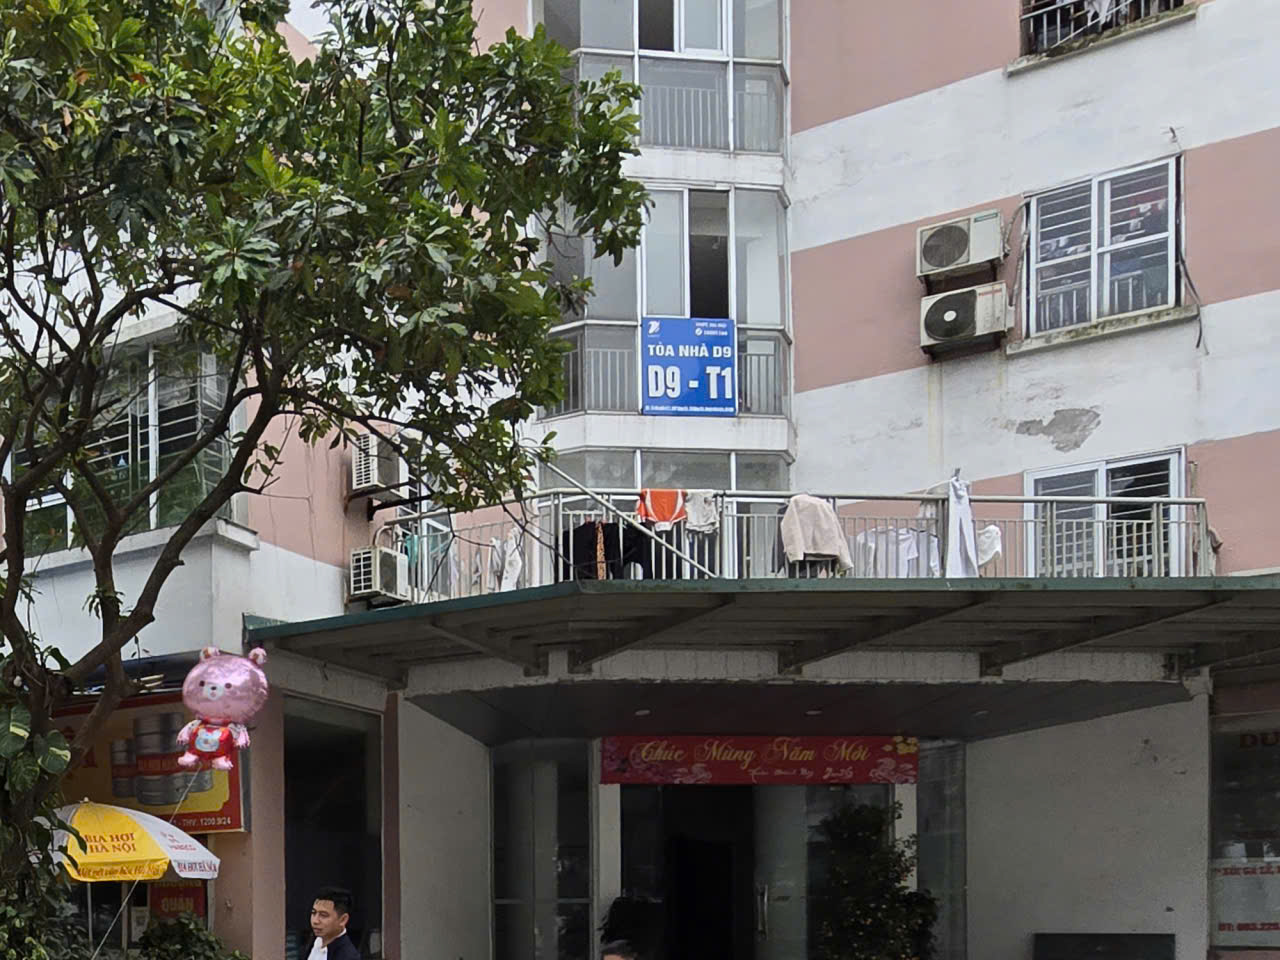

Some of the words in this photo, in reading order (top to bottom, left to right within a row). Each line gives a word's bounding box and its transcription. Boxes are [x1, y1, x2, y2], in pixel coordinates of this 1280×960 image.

[648, 341, 675, 356] TÒA
[679, 343, 709, 357] NHÀ
[713, 346, 732, 358] D9
[648, 365, 680, 398] D9
[706, 366, 733, 399] T1
[635, 740, 686, 761] Chúc
[770, 738, 816, 761] Năm
[84, 833, 107, 843] BIA
[109, 832, 134, 842] HƠI
[89, 842, 109, 853] HÀ
[112, 843, 136, 854] NỘI
